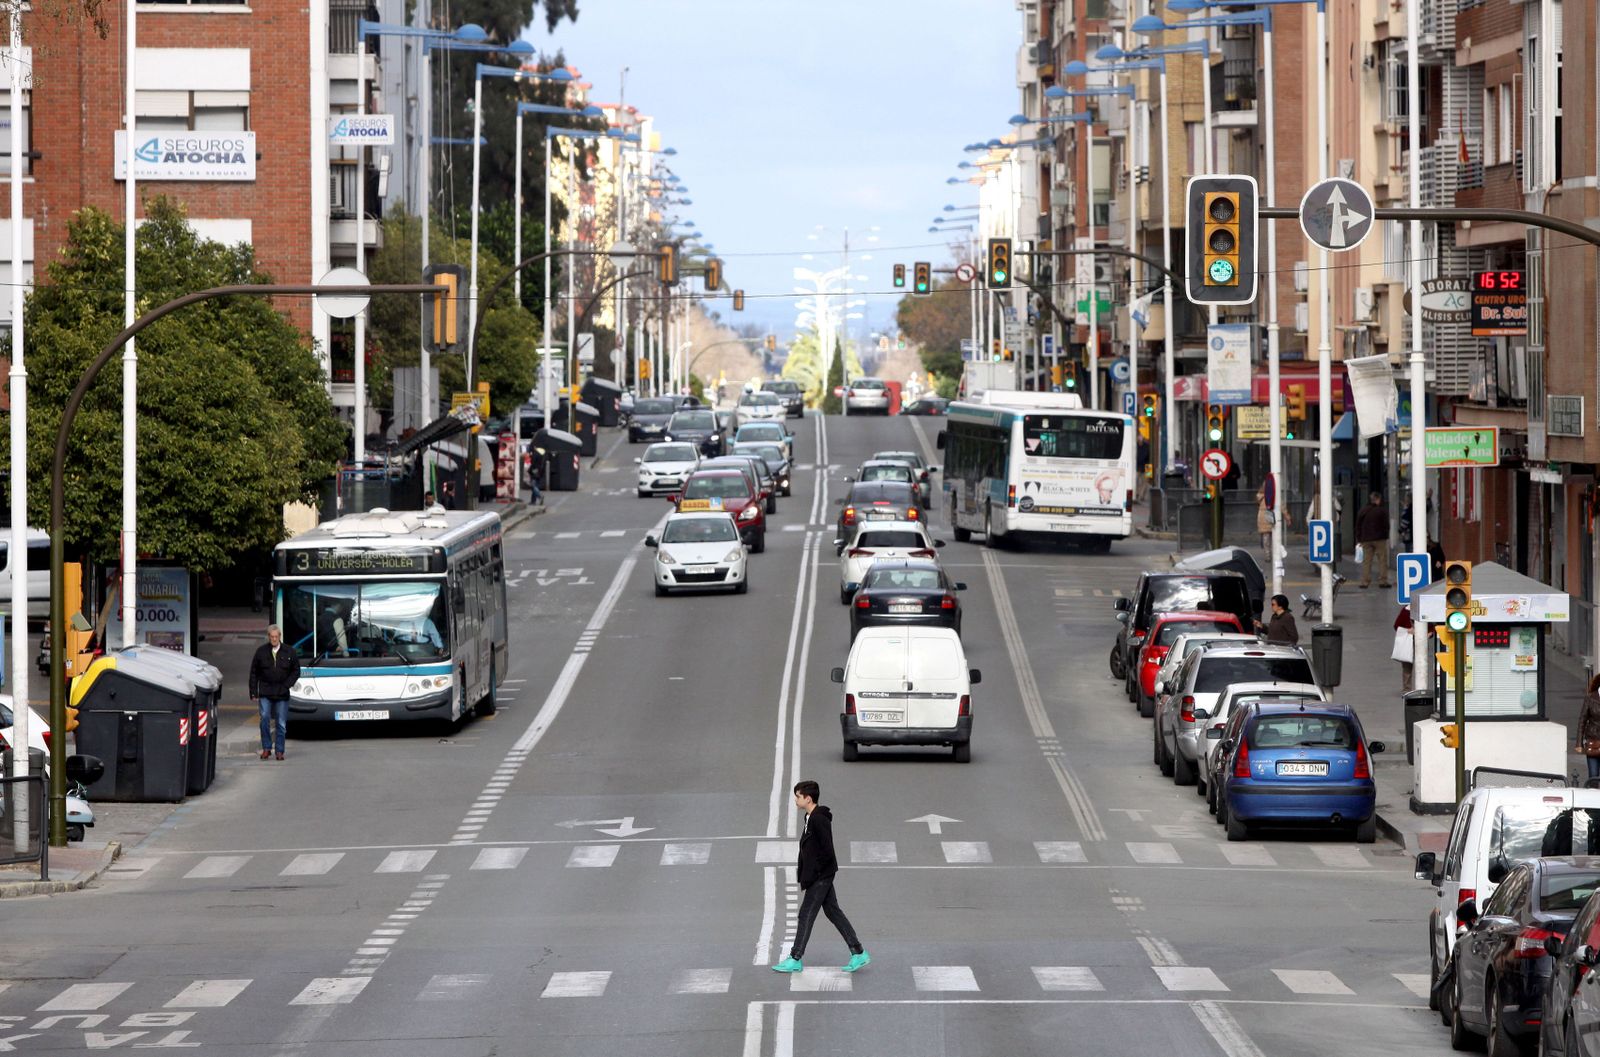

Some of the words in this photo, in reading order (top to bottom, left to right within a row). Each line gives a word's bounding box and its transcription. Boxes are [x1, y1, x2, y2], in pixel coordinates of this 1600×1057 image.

[348, 119, 387, 128] SEGUROS
[348, 128, 388, 136] ATOCHA
[164, 139, 245, 152] SEGUROS
[162, 152, 246, 163] ATOCHA
[1481, 272, 1495, 289] 16
[1500, 272, 1520, 289] 52
[1474, 295, 1506, 305] CENTRO
[1507, 295, 1526, 305] URO
[1480, 306, 1501, 320] Dr.
[1086, 424, 1120, 434] EMTUSA
[1312, 525, 1327, 558] P
[296, 552, 310, 571] 3
[1403, 559, 1423, 598] P
[866, 712, 883, 721] 0789
[887, 712, 900, 721] DZL
[1284, 764, 1306, 773] 0343
[1308, 764, 1325, 773] DNM
